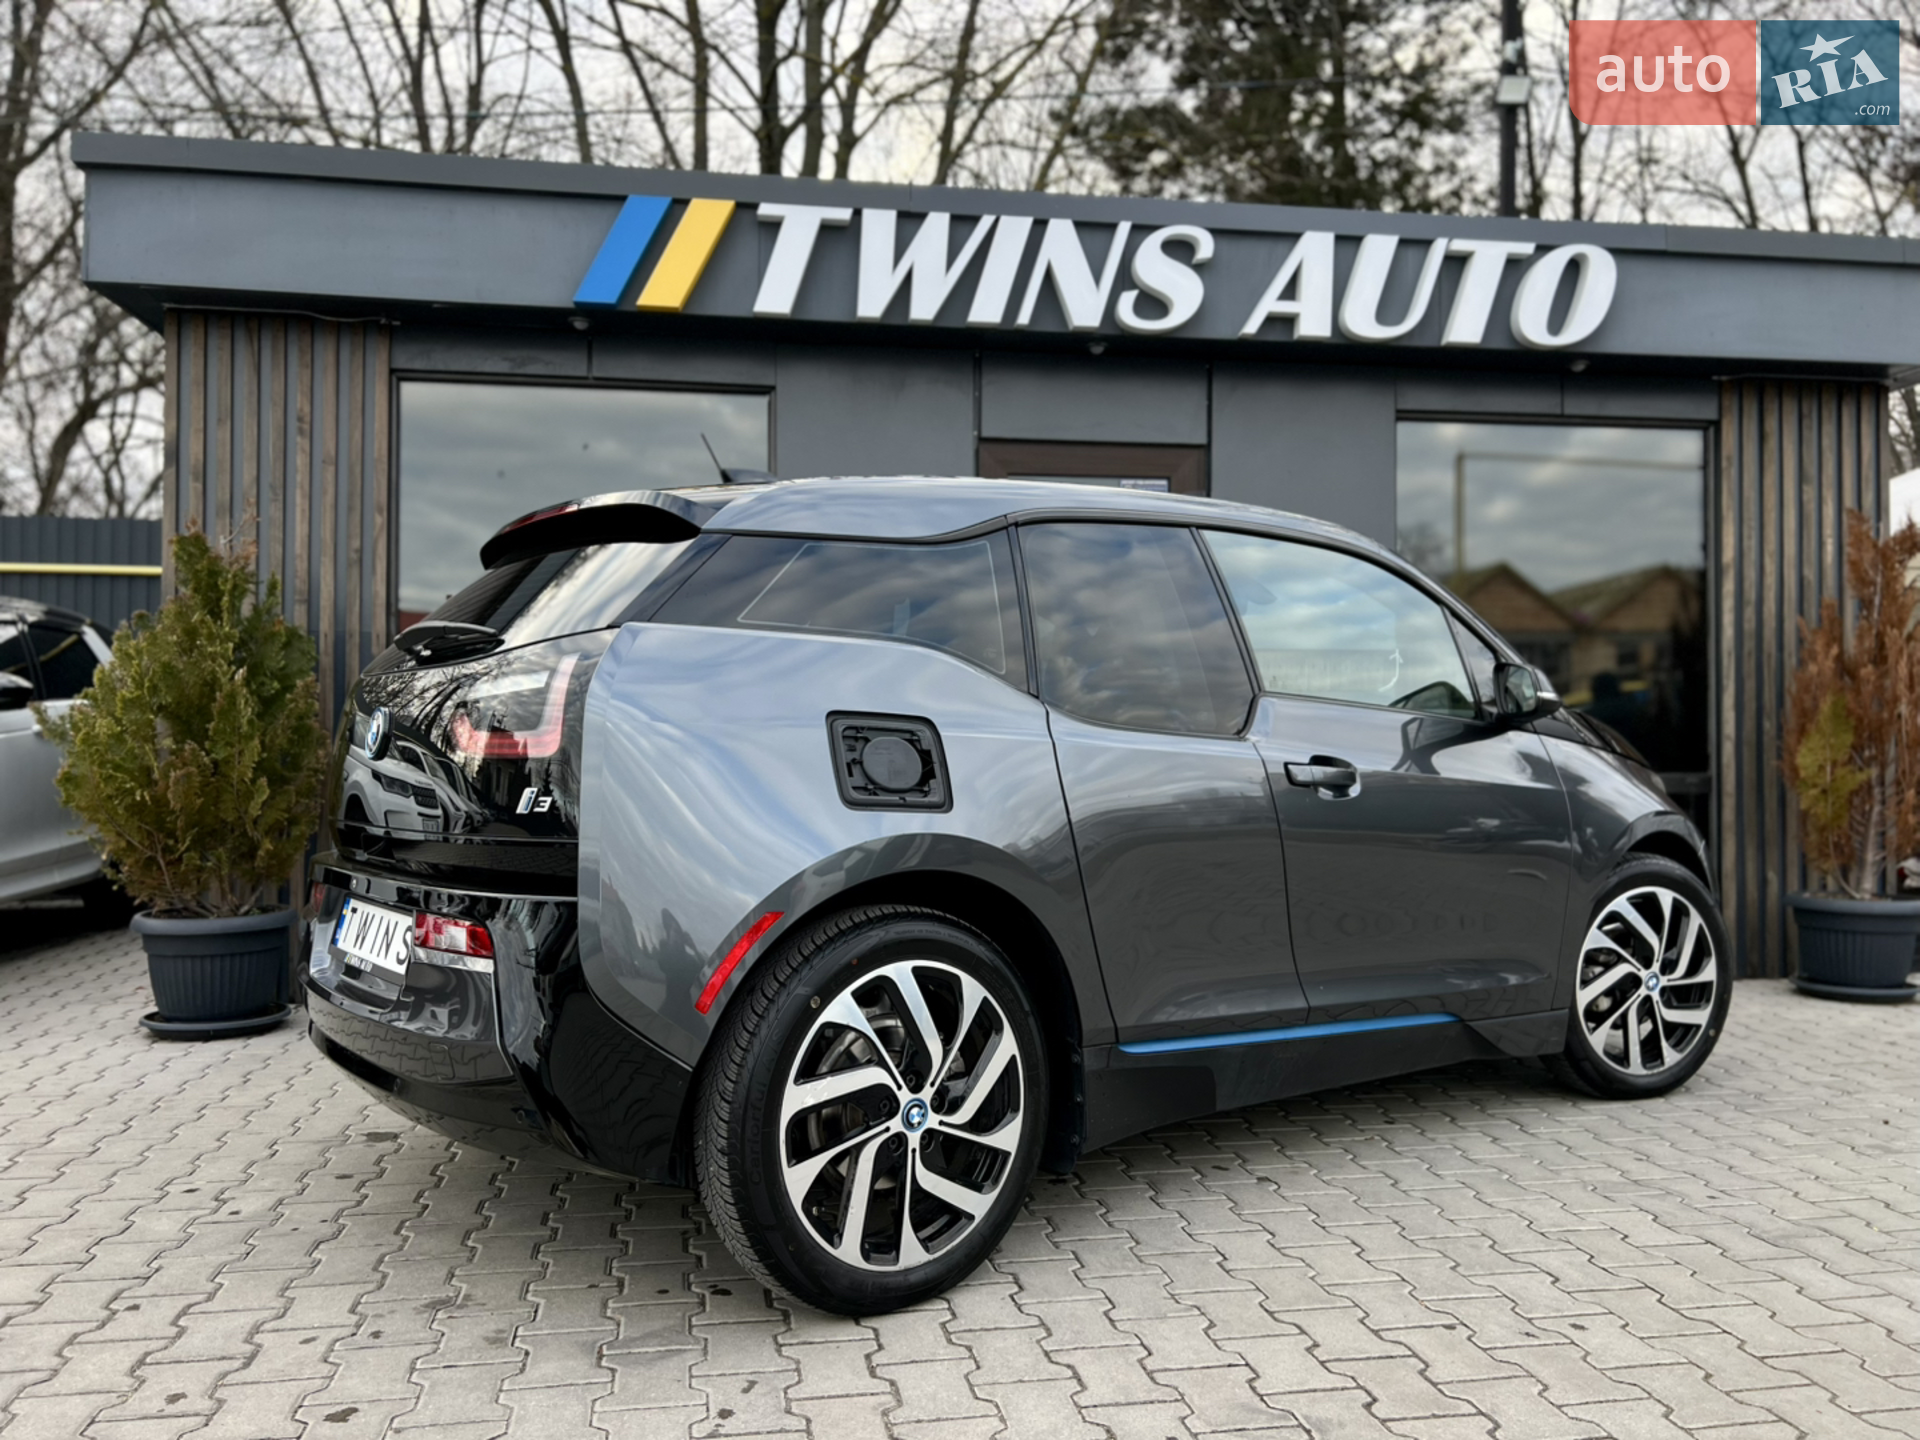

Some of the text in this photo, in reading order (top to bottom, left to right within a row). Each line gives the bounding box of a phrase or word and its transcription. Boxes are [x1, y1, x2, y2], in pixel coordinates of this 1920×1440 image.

[752, 202, 1618, 350] TWINS AUTO
[515, 787, 553, 814] i3
[342, 906, 413, 966] TWINS
